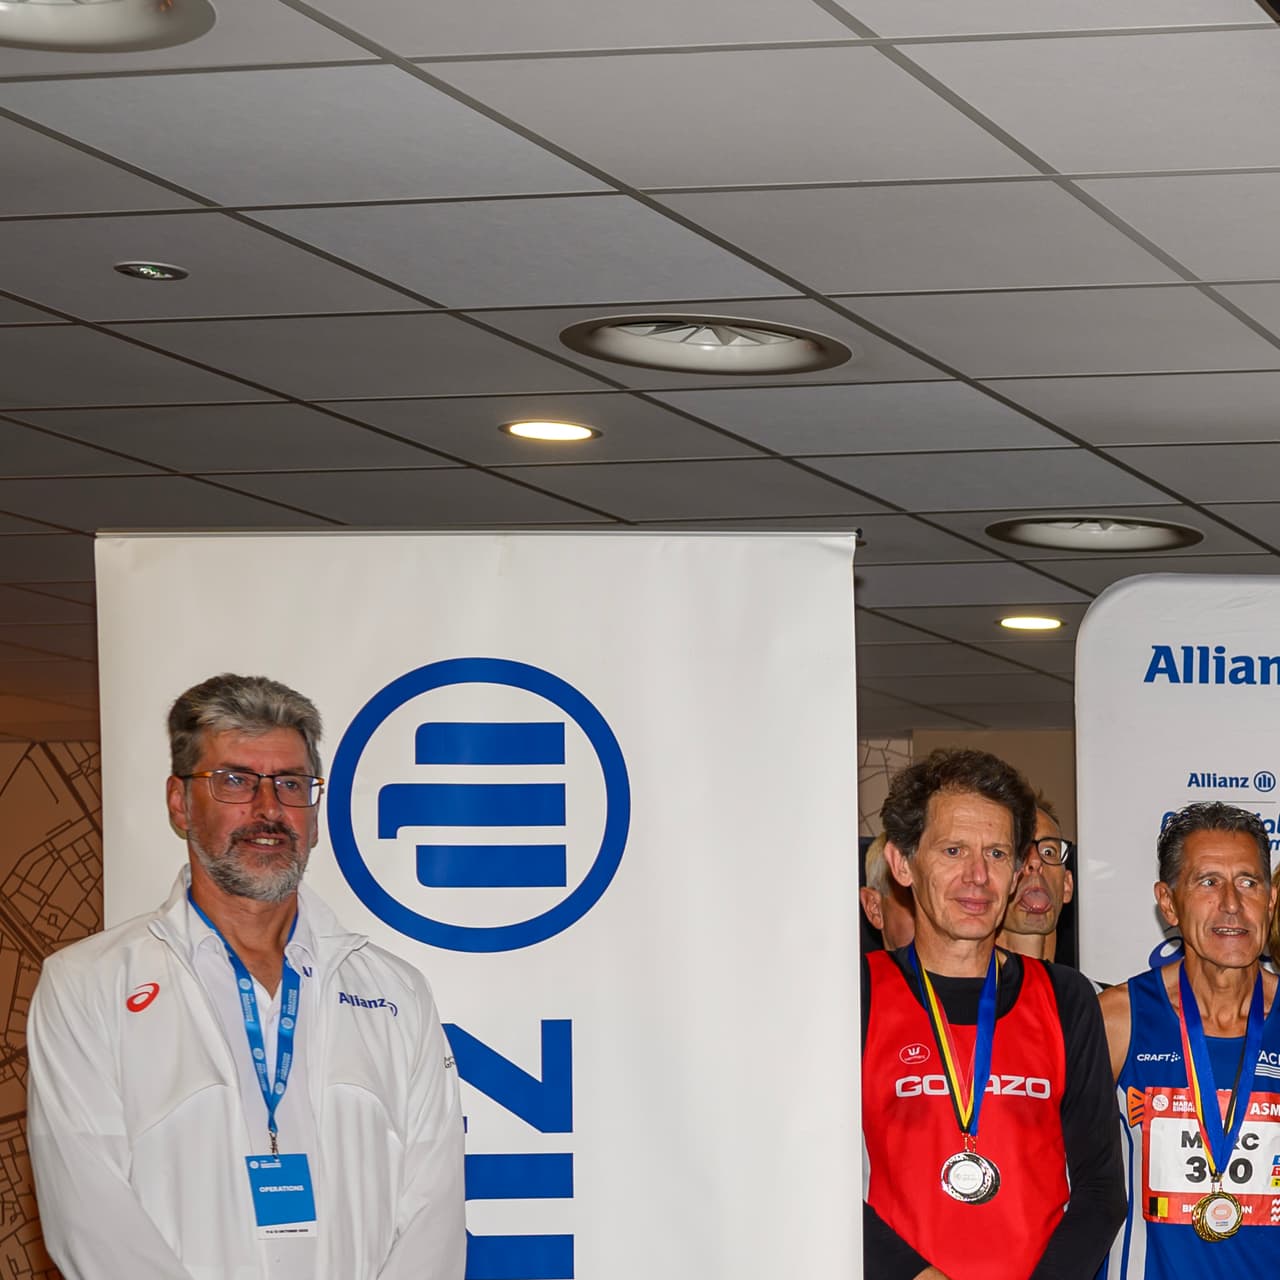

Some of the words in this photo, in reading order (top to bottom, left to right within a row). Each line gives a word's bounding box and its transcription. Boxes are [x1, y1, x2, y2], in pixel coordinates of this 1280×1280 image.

[1187, 773, 1250, 788] Allianz
[1137, 1053, 1171, 1062] CRAFT
[895, 1074, 1050, 1099] GOAZO
[1185, 1156, 1253, 1184] 30
